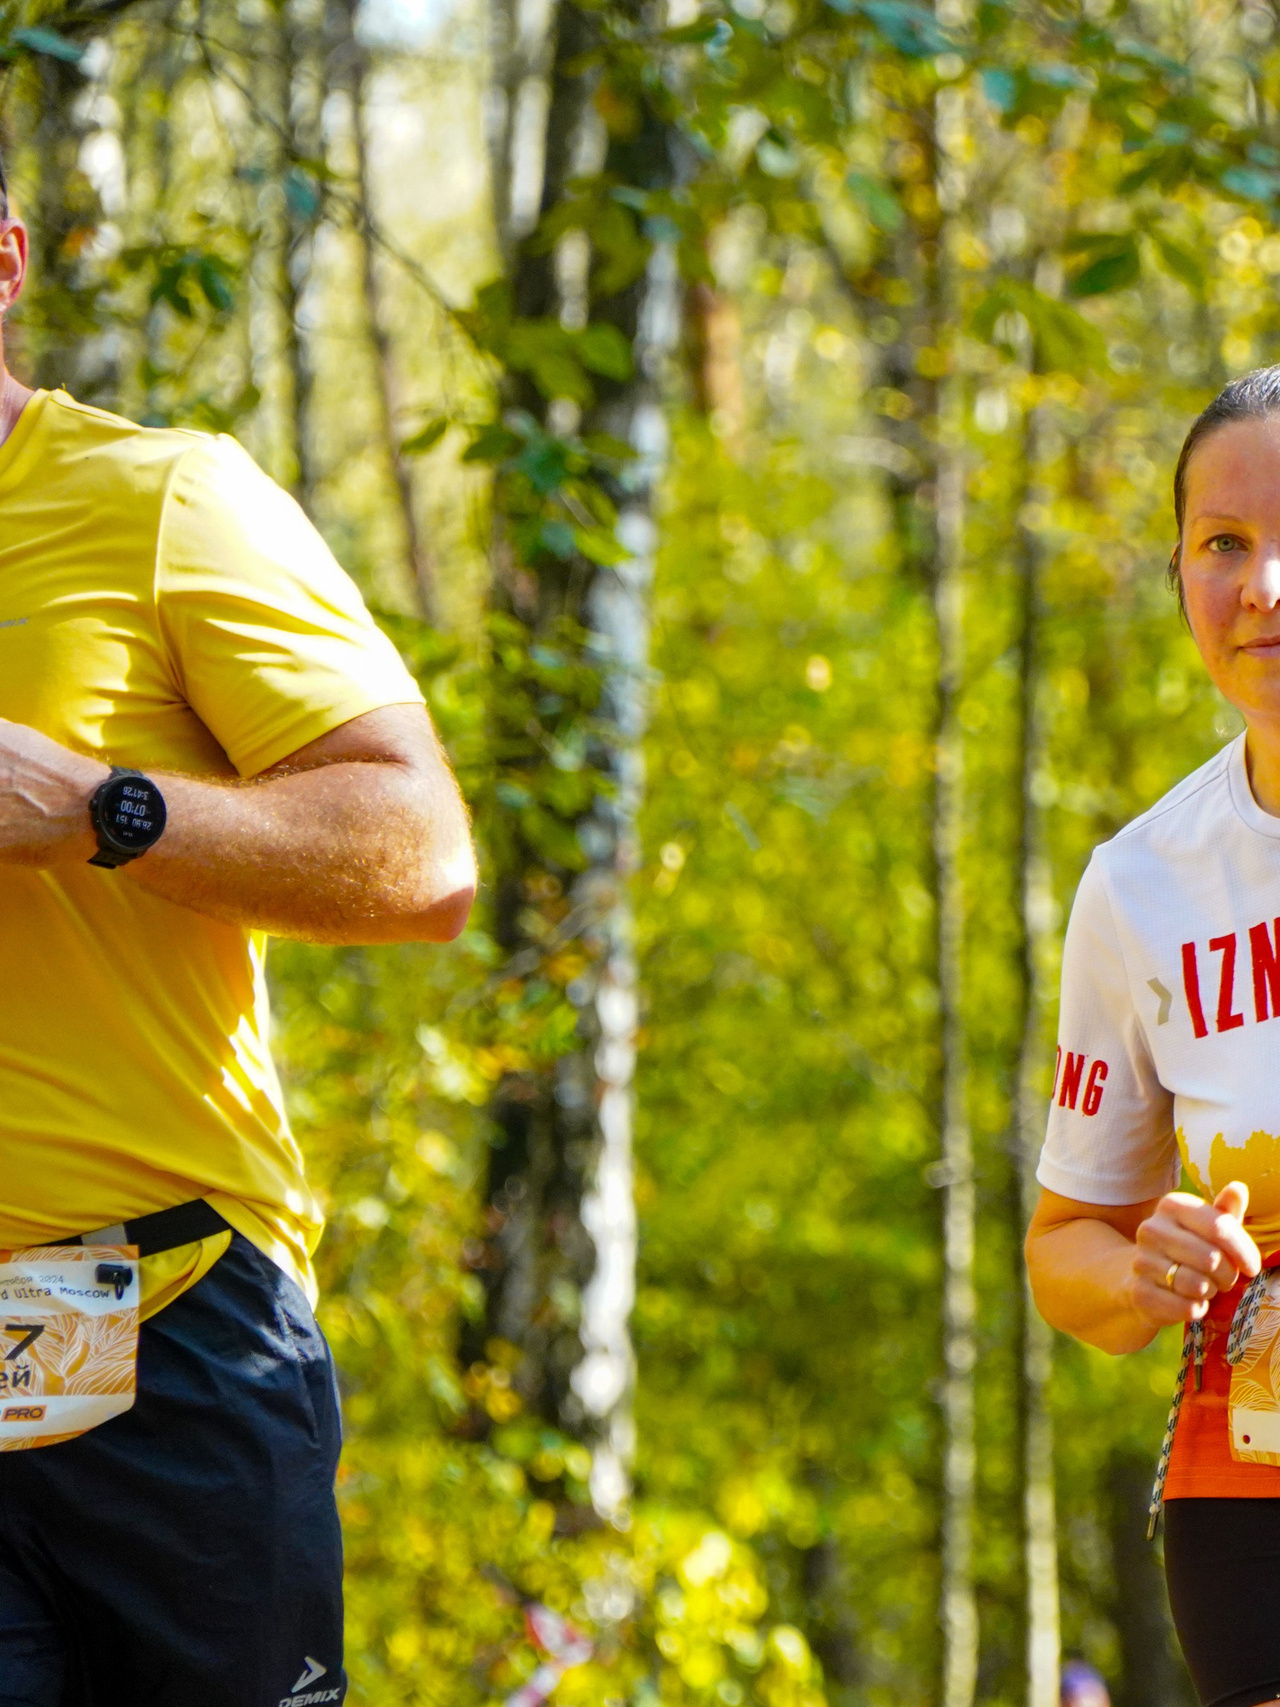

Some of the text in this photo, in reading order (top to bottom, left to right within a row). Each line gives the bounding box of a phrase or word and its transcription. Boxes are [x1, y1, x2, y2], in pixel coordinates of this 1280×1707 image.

[1052, 1044, 1109, 1117] NG
[13, 1287, 52, 1299] Ultra
[59, 1286, 110, 1299] Moscow
[4, 1406, 44, 1420] PRO
[278, 1687, 341, 1707] DEMIX
